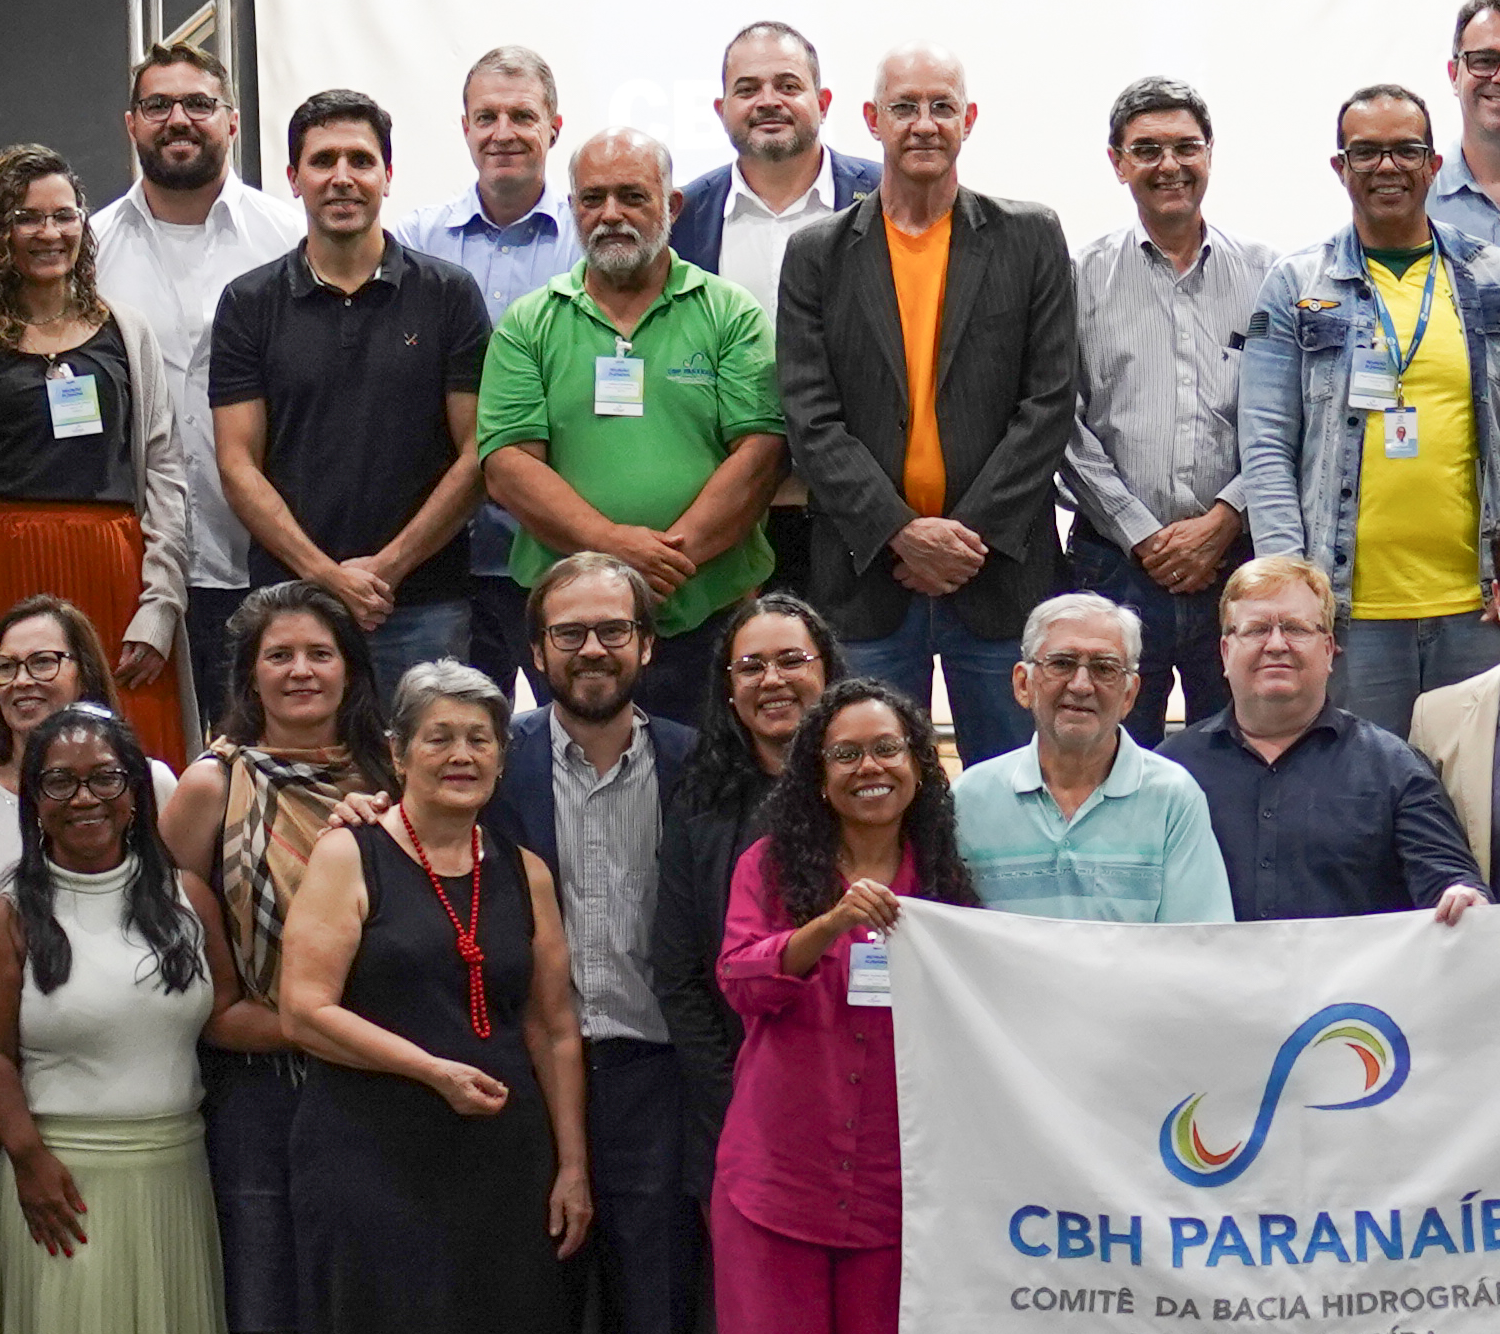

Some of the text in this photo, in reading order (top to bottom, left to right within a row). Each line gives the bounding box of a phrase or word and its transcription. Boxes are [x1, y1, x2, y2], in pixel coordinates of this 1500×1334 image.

[1008, 1203, 1143, 1267] CBH
[1010, 1285, 1135, 1315] COMITÊ
[1155, 1296, 1200, 1320] DA
[1212, 1295, 1311, 1322] BACIA
